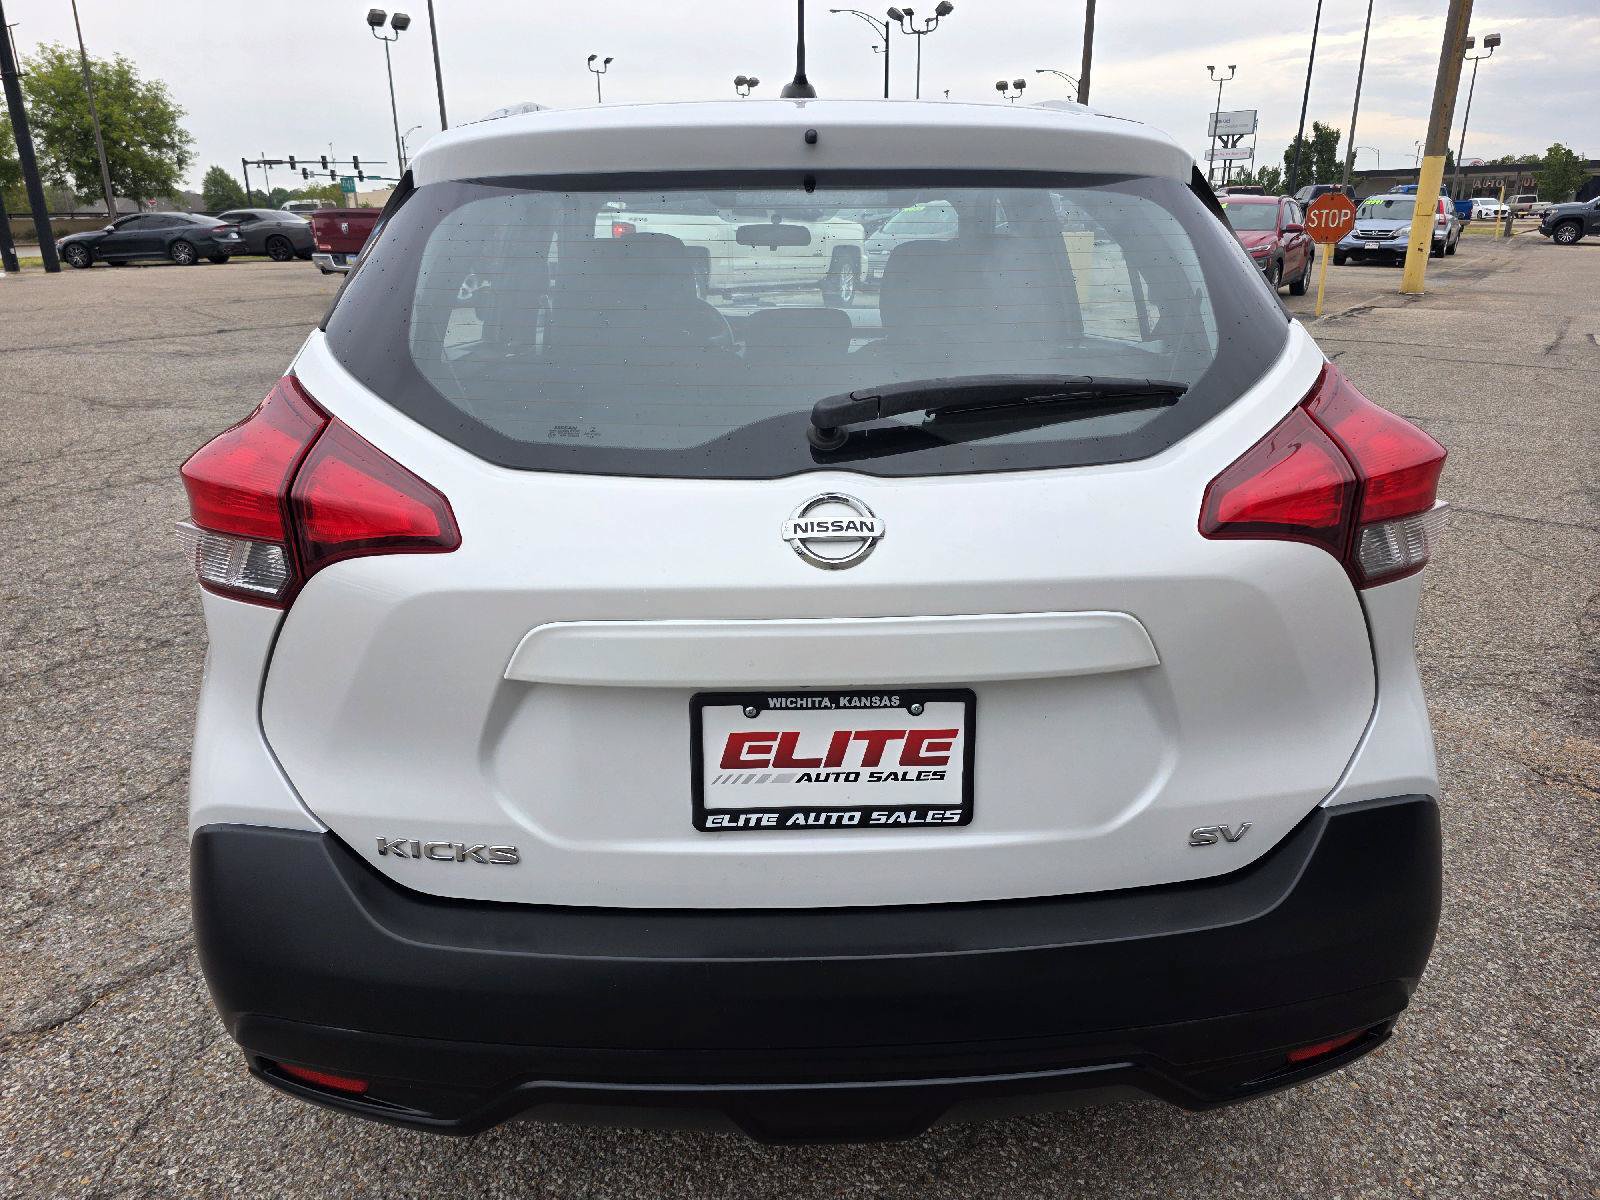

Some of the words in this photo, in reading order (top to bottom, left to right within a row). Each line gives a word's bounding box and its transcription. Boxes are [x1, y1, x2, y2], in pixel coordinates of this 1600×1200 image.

[1473, 178, 1505, 188] AUTO
[1308, 209, 1351, 228] STOP
[793, 520, 875, 534] NISSAN
[768, 696, 836, 710] WICHITA,
[840, 695, 900, 708] KANSAS
[720, 728, 959, 769] ELITE
[795, 771, 860, 783] AUTO
[867, 770, 947, 783] SALES
[705, 813, 778, 828] ELITE
[786, 811, 861, 826] AUTO
[870, 809, 962, 825] SALES
[1189, 822, 1253, 847] SV
[375, 836, 520, 865] KICKS
